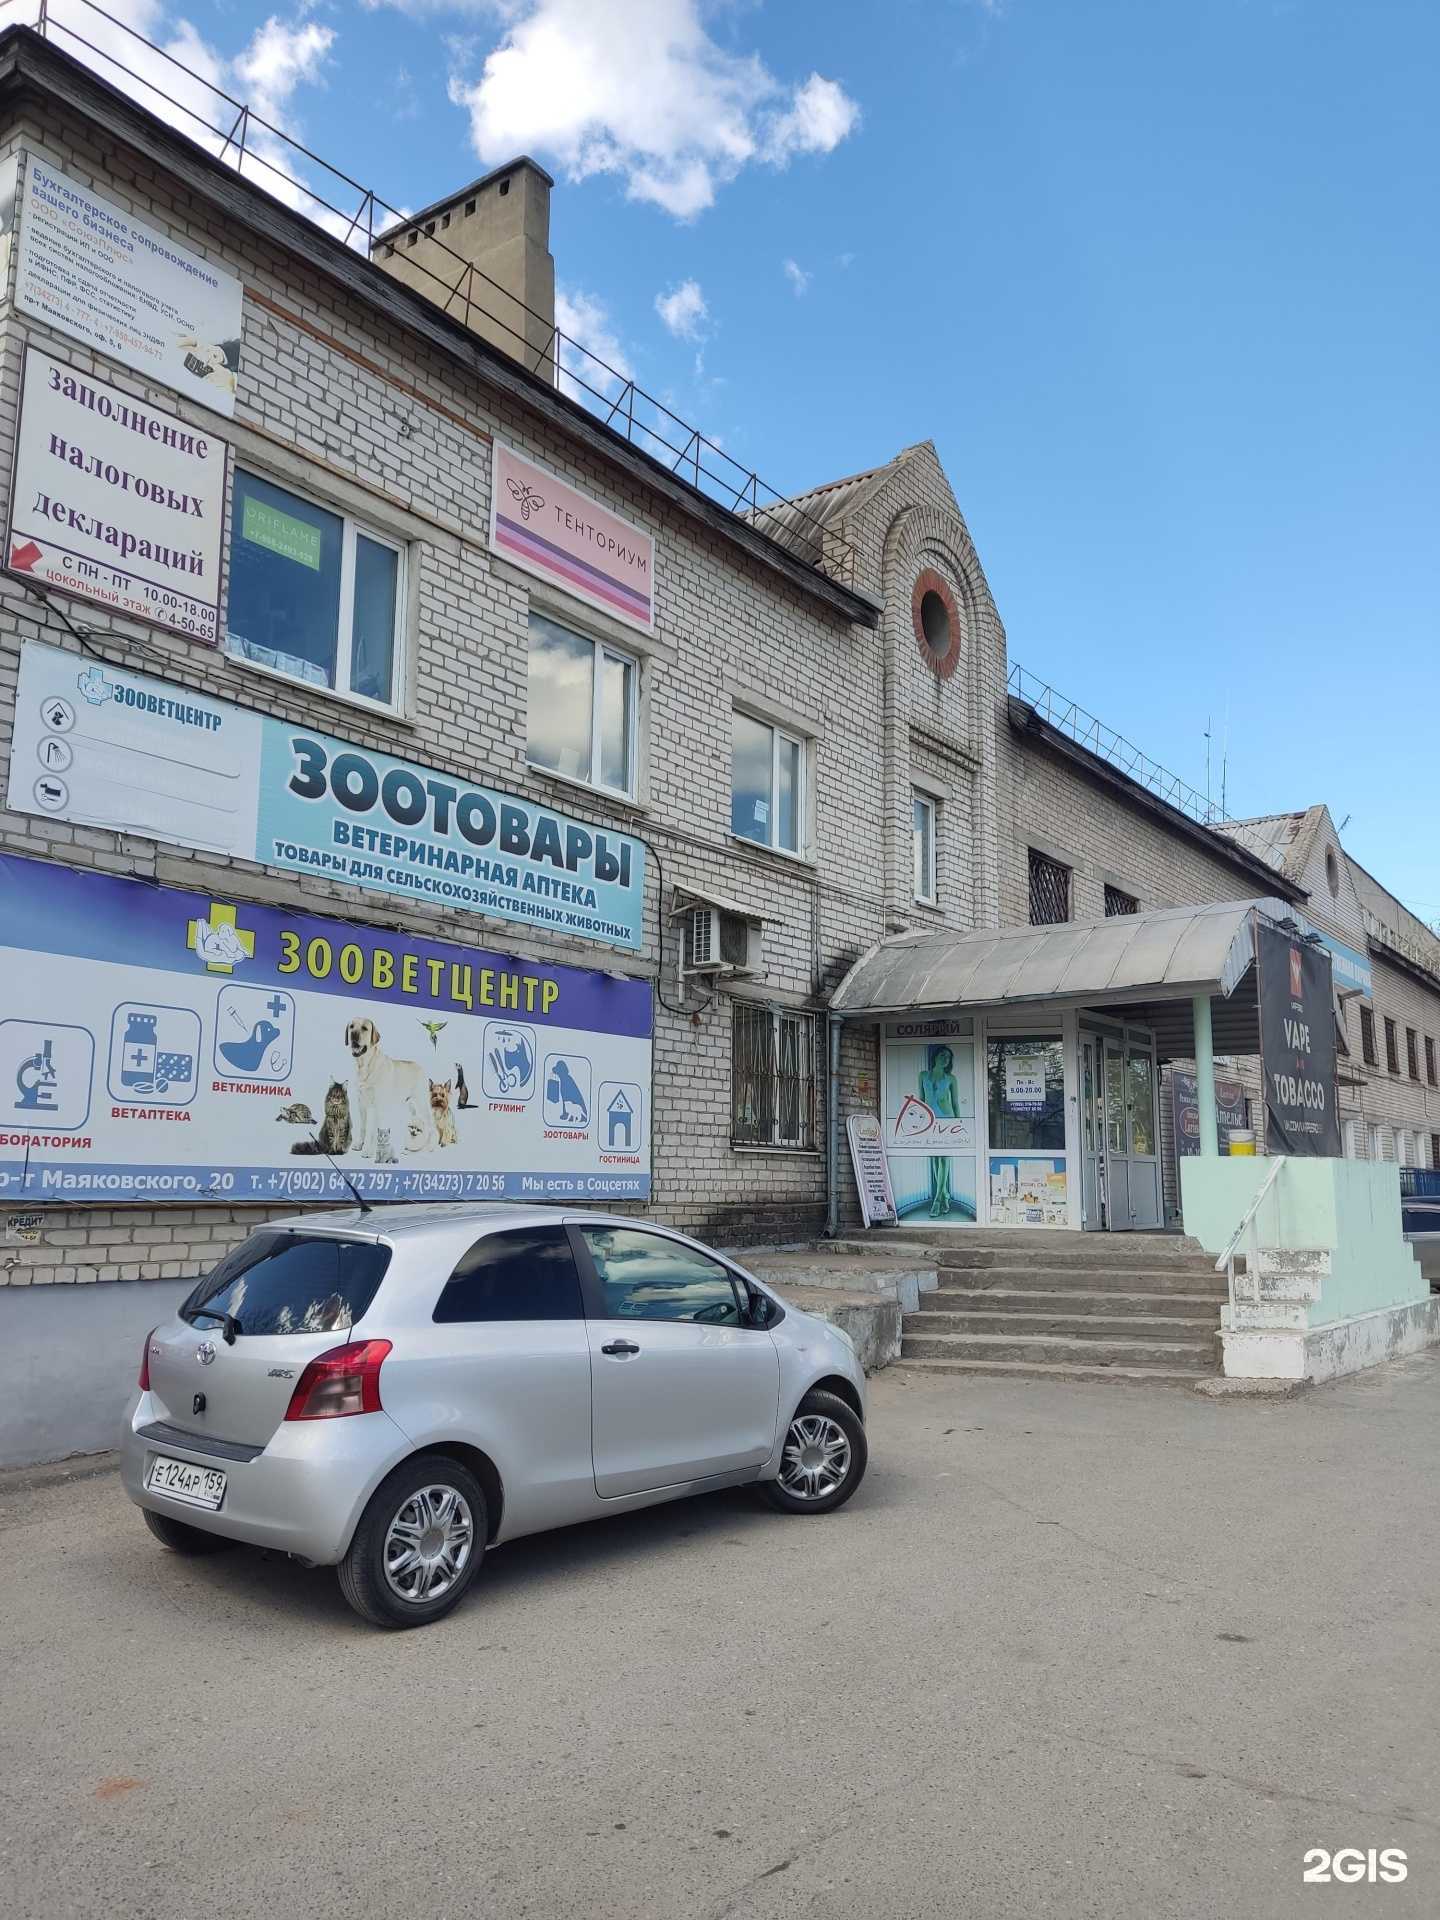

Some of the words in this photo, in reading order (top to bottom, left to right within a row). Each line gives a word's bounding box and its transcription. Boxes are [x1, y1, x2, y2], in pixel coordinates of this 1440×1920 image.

[31, 198, 57, 221] ООО
[31, 184, 79, 220] вашего
[83, 214, 133, 252] бизнеса
[33, 167, 127, 233] Бухгалтерское
[131, 229, 217, 288] сопровождение
[31, 228, 61, 249] ведение
[63, 246, 115, 279] бухгалтерского
[49, 245, 73, 263] систем
[79, 239, 89, 250] ИП
[97, 250, 113, 264] ООО
[29, 249, 69, 276] подготовка
[99, 288, 136, 312] отчетности
[72, 293, 85, 305] для
[24, 294, 39, 307] пр-т
[41, 303, 92, 335] Маяковского,
[98, 295, 134, 320] статистику
[48, 367, 208, 459] заполнение
[49, 433, 204, 518] налоговых
[32, 492, 205, 577] деклараций
[247, 507, 318, 546] ORIFLAME
[554, 506, 646, 572] ТЕНТОРИУМ
[46, 568, 119, 604] цокольный
[122, 597, 151, 617] этаж
[168, 611, 214, 639] 4-50-65
[62, 556, 72, 569] С
[78, 562, 98, 580] ПН
[112, 575, 131, 591] ПТ
[143, 586, 216, 622] 10.00-18.00
[114, 684, 222, 732] ЗООВЕТЦЕНТР
[289, 738, 631, 888] ЗООТОВАРЫ
[334, 820, 518, 889] ВЕТЕРИНАРНАЯ
[522, 876, 597, 909] АПТЕКА
[274, 842, 346, 872] ТОВАРЫ
[350, 859, 382, 881] ДЛЯ
[386, 868, 564, 924] СЕЛЬСКОХОЗЯЙСТВЕННЫХ
[566, 912, 632, 940] ЖИВОТНЫХ
[278, 930, 560, 1016] ЗООВЕТЦЕНТР
[1283, 1018, 1311, 1054] VAPE
[212, 1081, 292, 1097] ВЕТКЛИНИКА
[488, 1103, 526, 1113] ГРУМИНГ
[1274, 1074, 1325, 1111] TOBACCO
[111, 1107, 192, 1122] ВЕТАПТЕКА
[543, 1130, 589, 1141] ЗООТОВАРЫ
[599, 1155, 641, 1164] ГОСТИНИЦА
[42, 1170, 202, 1192] Маяковского,
[209, 1172, 234, 1190] 20
[250, 1174, 263, 1190] т.
[268, 1172, 325, 1194] +7(902)
[329, 1172, 346, 1190] 64
[403, 1174, 464, 1194] +7(34273)
[466, 1174, 474, 1190] 7
[476, 1174, 490, 1190] 20
[492, 1174, 504, 1190] 56
[522, 1176, 544, 1190] Мы
[546, 1179, 574, 1191] есть
[577, 1179, 584, 1190] в
[587, 1178, 640, 1193] Соцсетях
[8, 1216, 44, 1228] КРЕДИТ
[156, 1464, 200, 1492] Е124АР
[204, 1472, 223, 1492] 159
